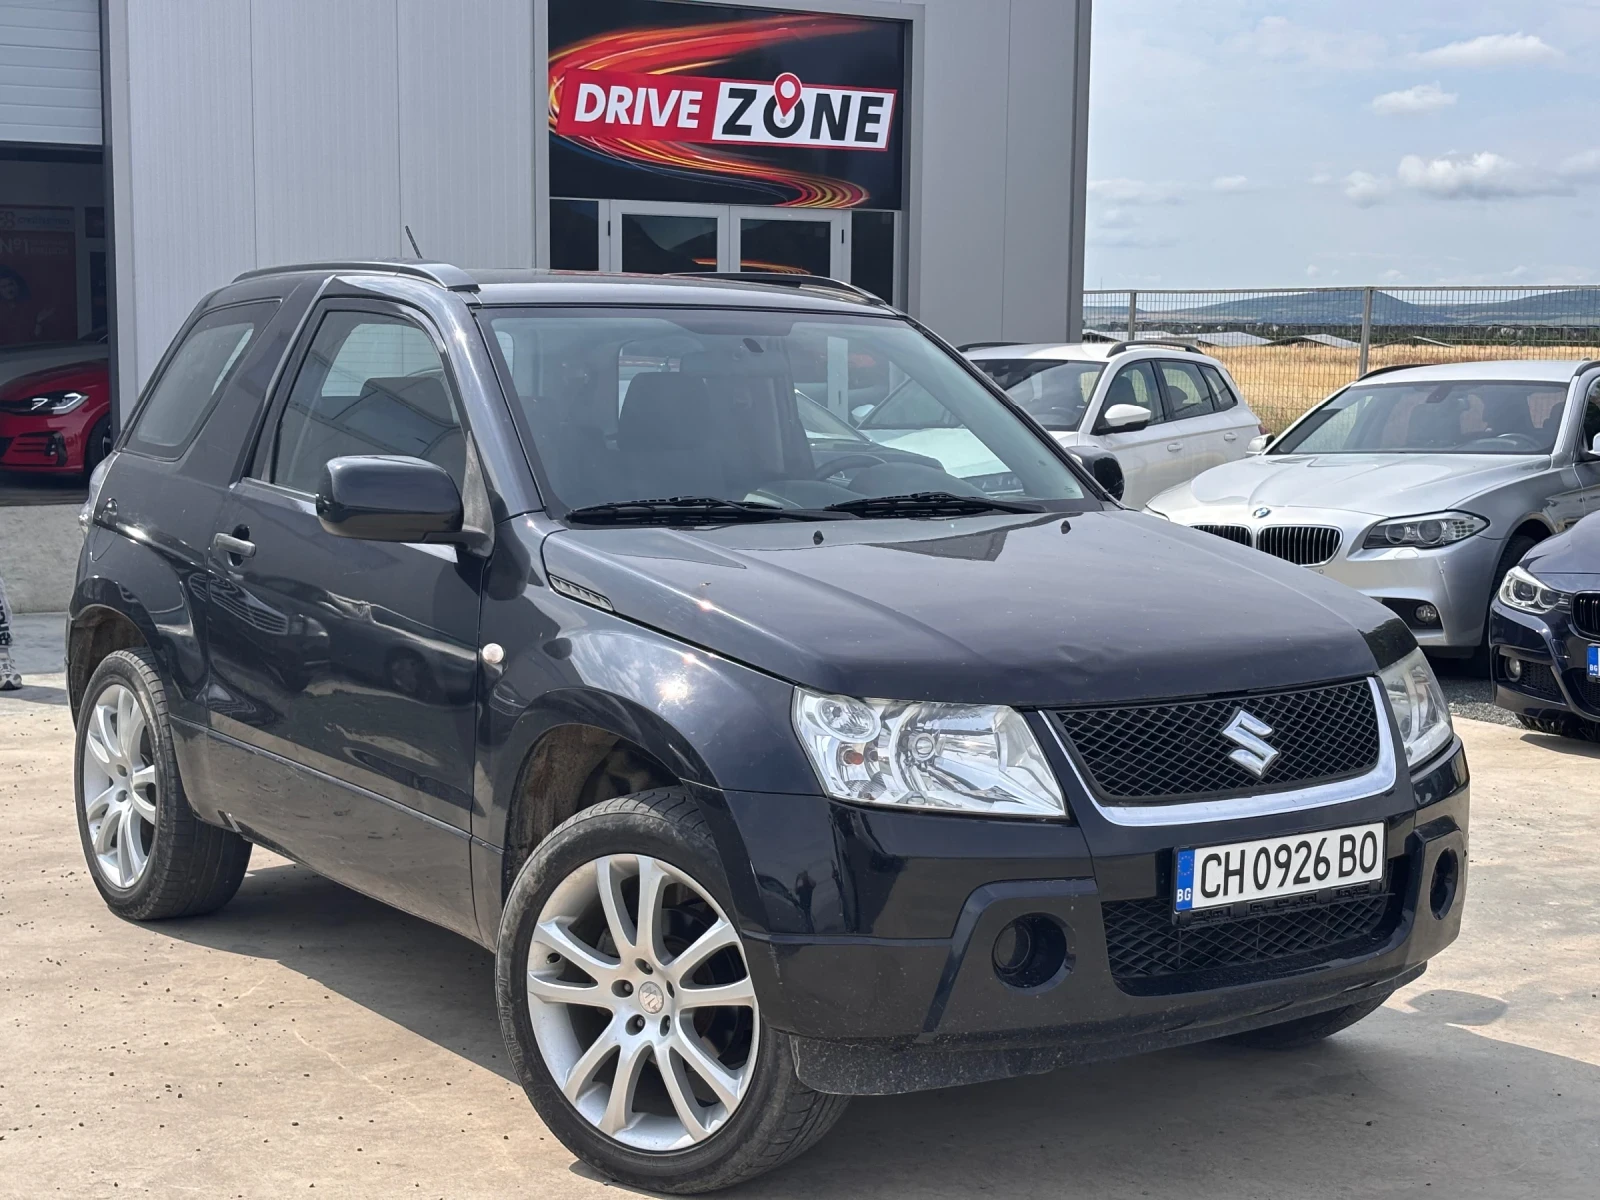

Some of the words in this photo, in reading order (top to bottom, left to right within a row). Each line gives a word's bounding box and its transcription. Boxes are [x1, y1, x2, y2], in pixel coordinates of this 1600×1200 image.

[575, 83, 703, 129] DRIVE
[722, 87, 885, 143] ZONE
[1589, 664, 1598, 672] BG
[1200, 849, 1246, 898] CH
[1253, 837, 1331, 891] 0926
[1176, 888, 1192, 902] BG
